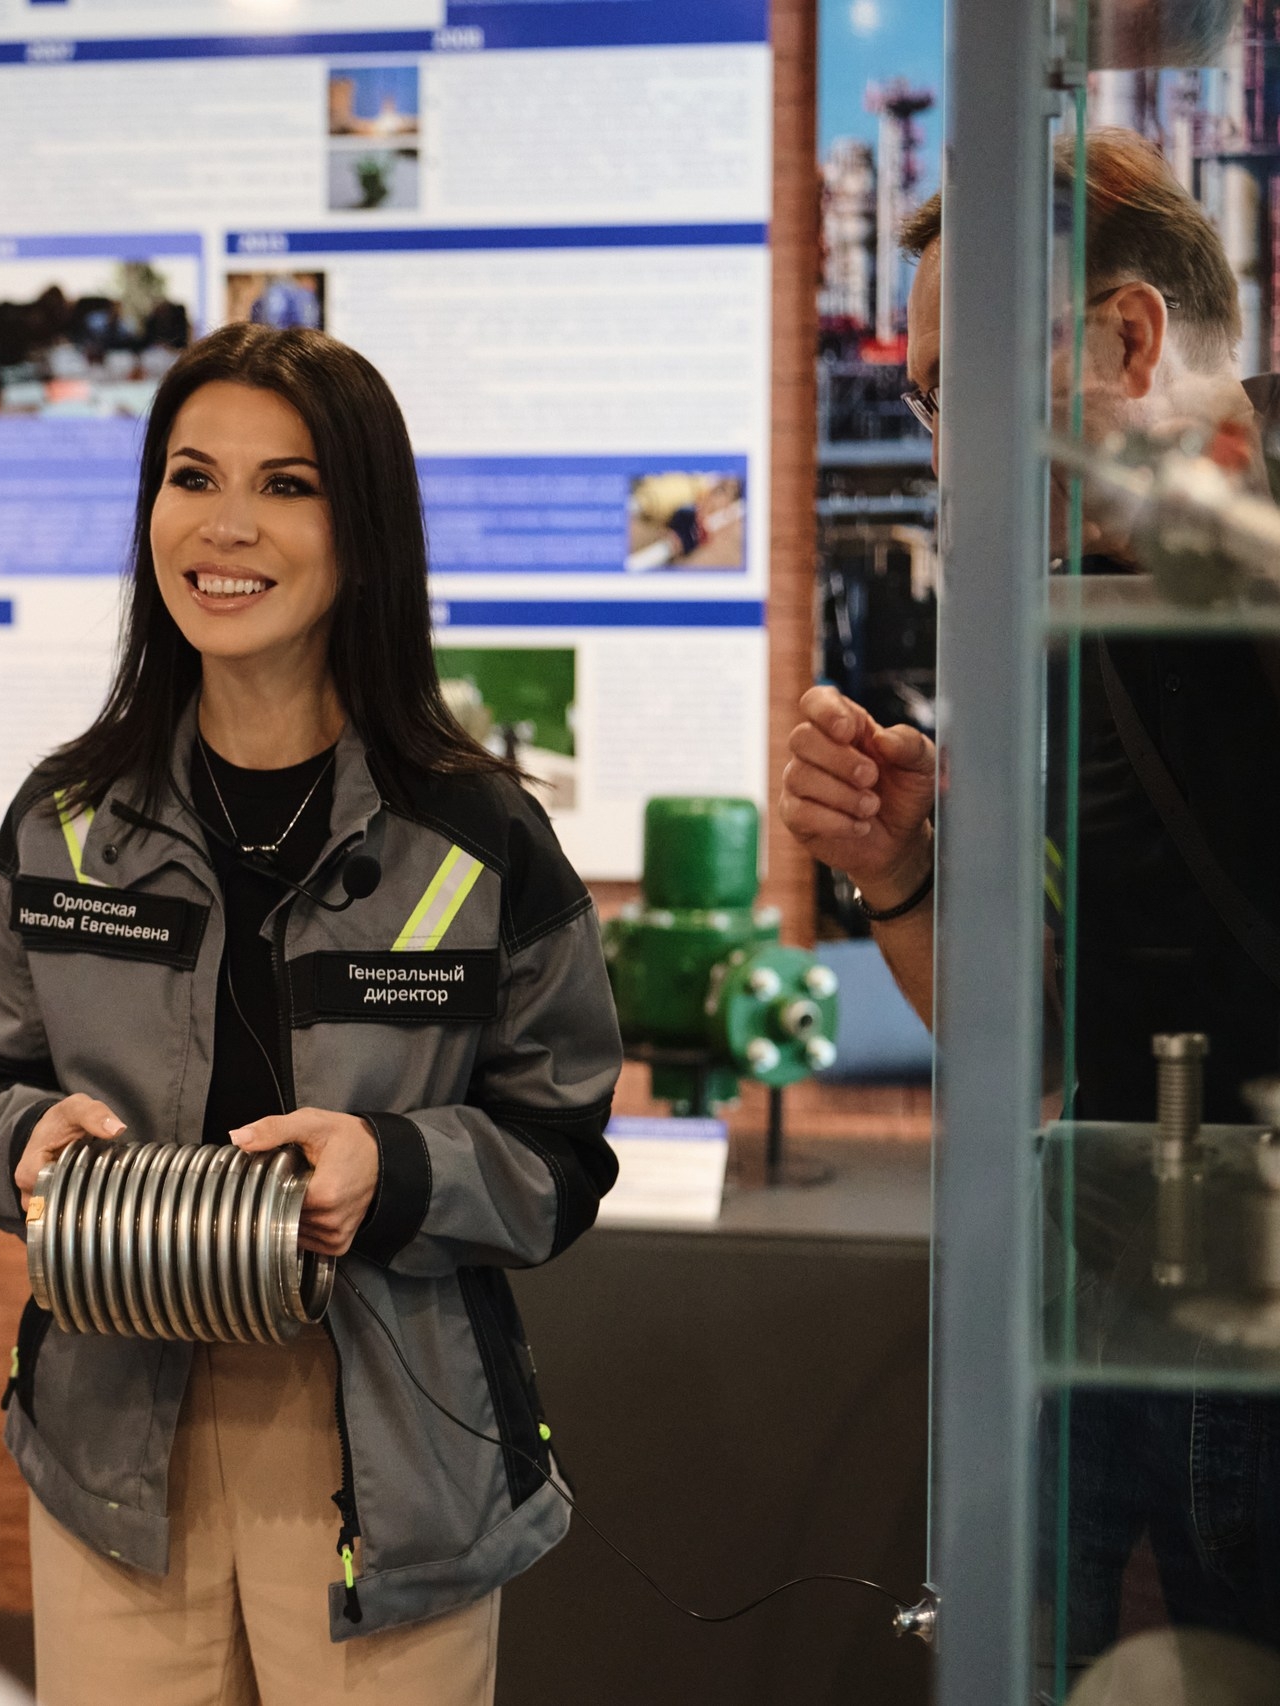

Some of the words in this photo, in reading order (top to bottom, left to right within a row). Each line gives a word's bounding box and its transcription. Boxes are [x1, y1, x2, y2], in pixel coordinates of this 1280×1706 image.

[53, 892, 137, 918] Орловская
[20, 908, 75, 930] Наталья
[80, 915, 170, 942] Евгеньевна
[349, 963, 465, 985] Генеральный
[363, 987, 449, 1006] директор
